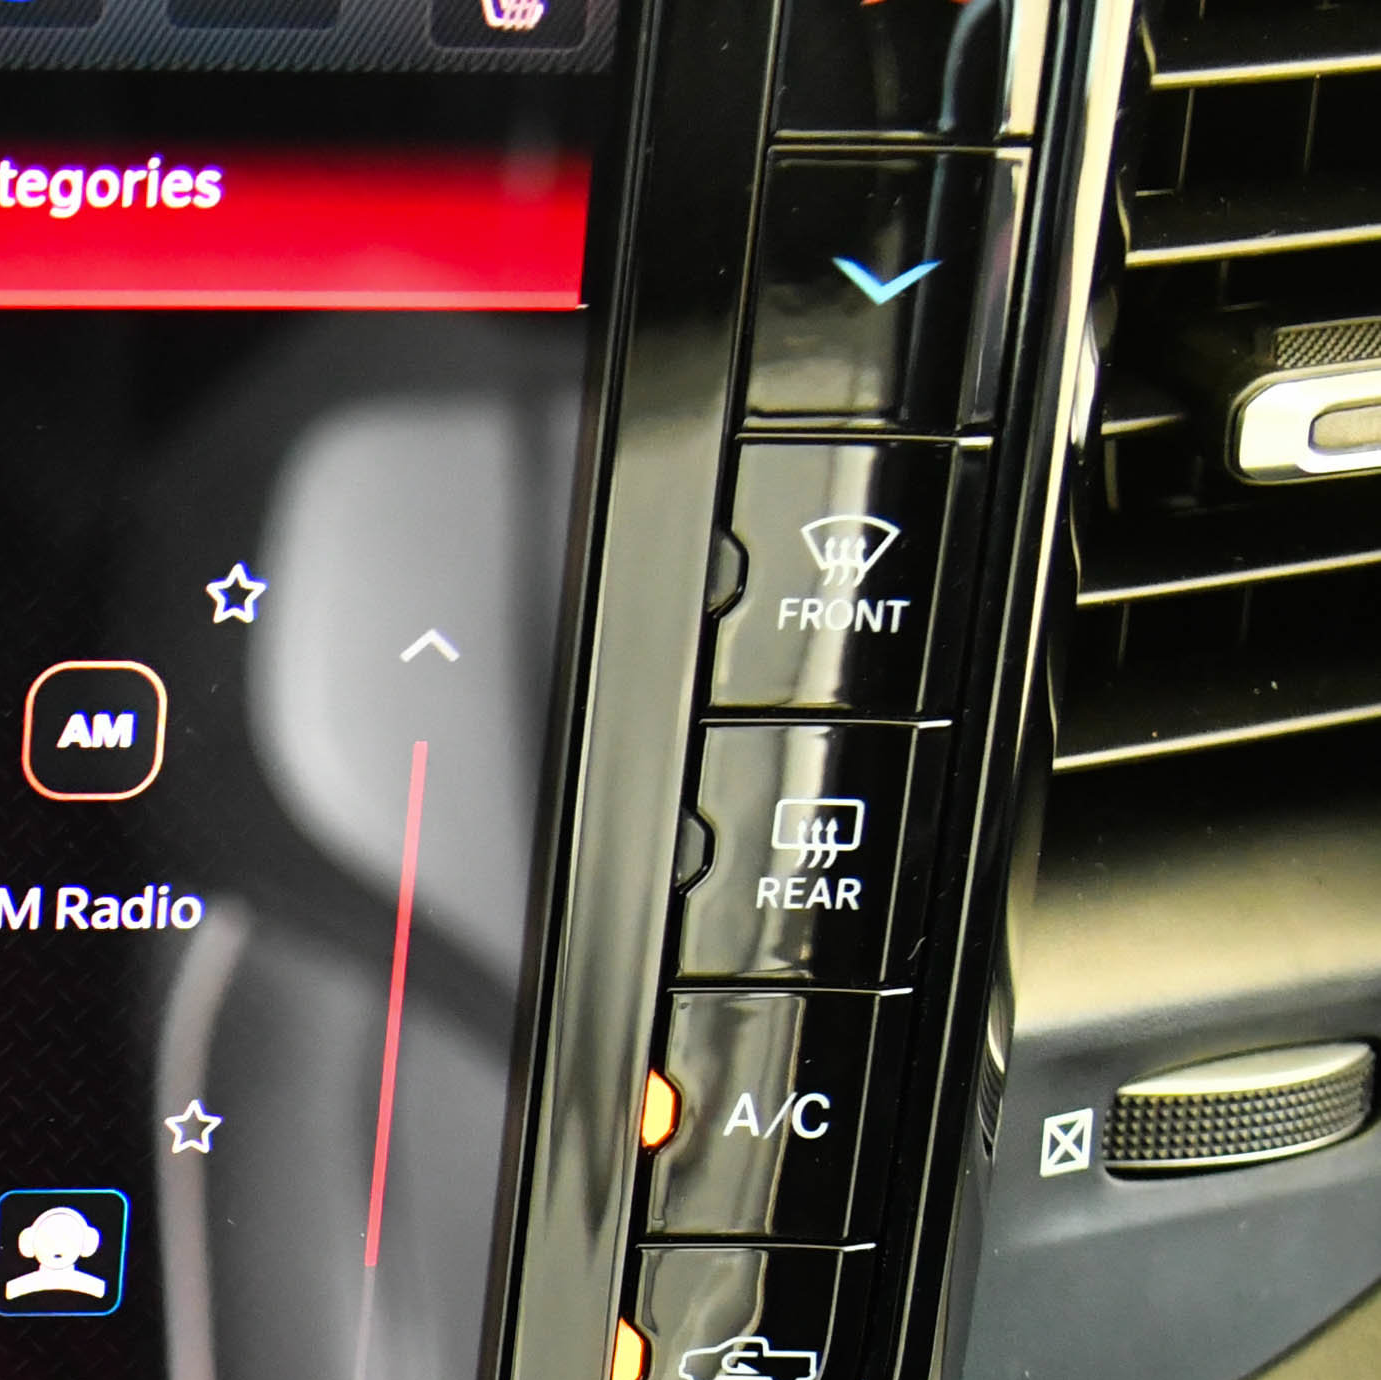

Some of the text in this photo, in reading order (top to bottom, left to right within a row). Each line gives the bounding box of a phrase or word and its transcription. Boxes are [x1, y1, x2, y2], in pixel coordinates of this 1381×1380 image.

[776, 596, 911, 636] FRONT
[55, 712, 135, 749] AM
[55, 885, 204, 932] Radio
[754, 876, 863, 913] REAR
[722, 1092, 831, 1141] A/C
